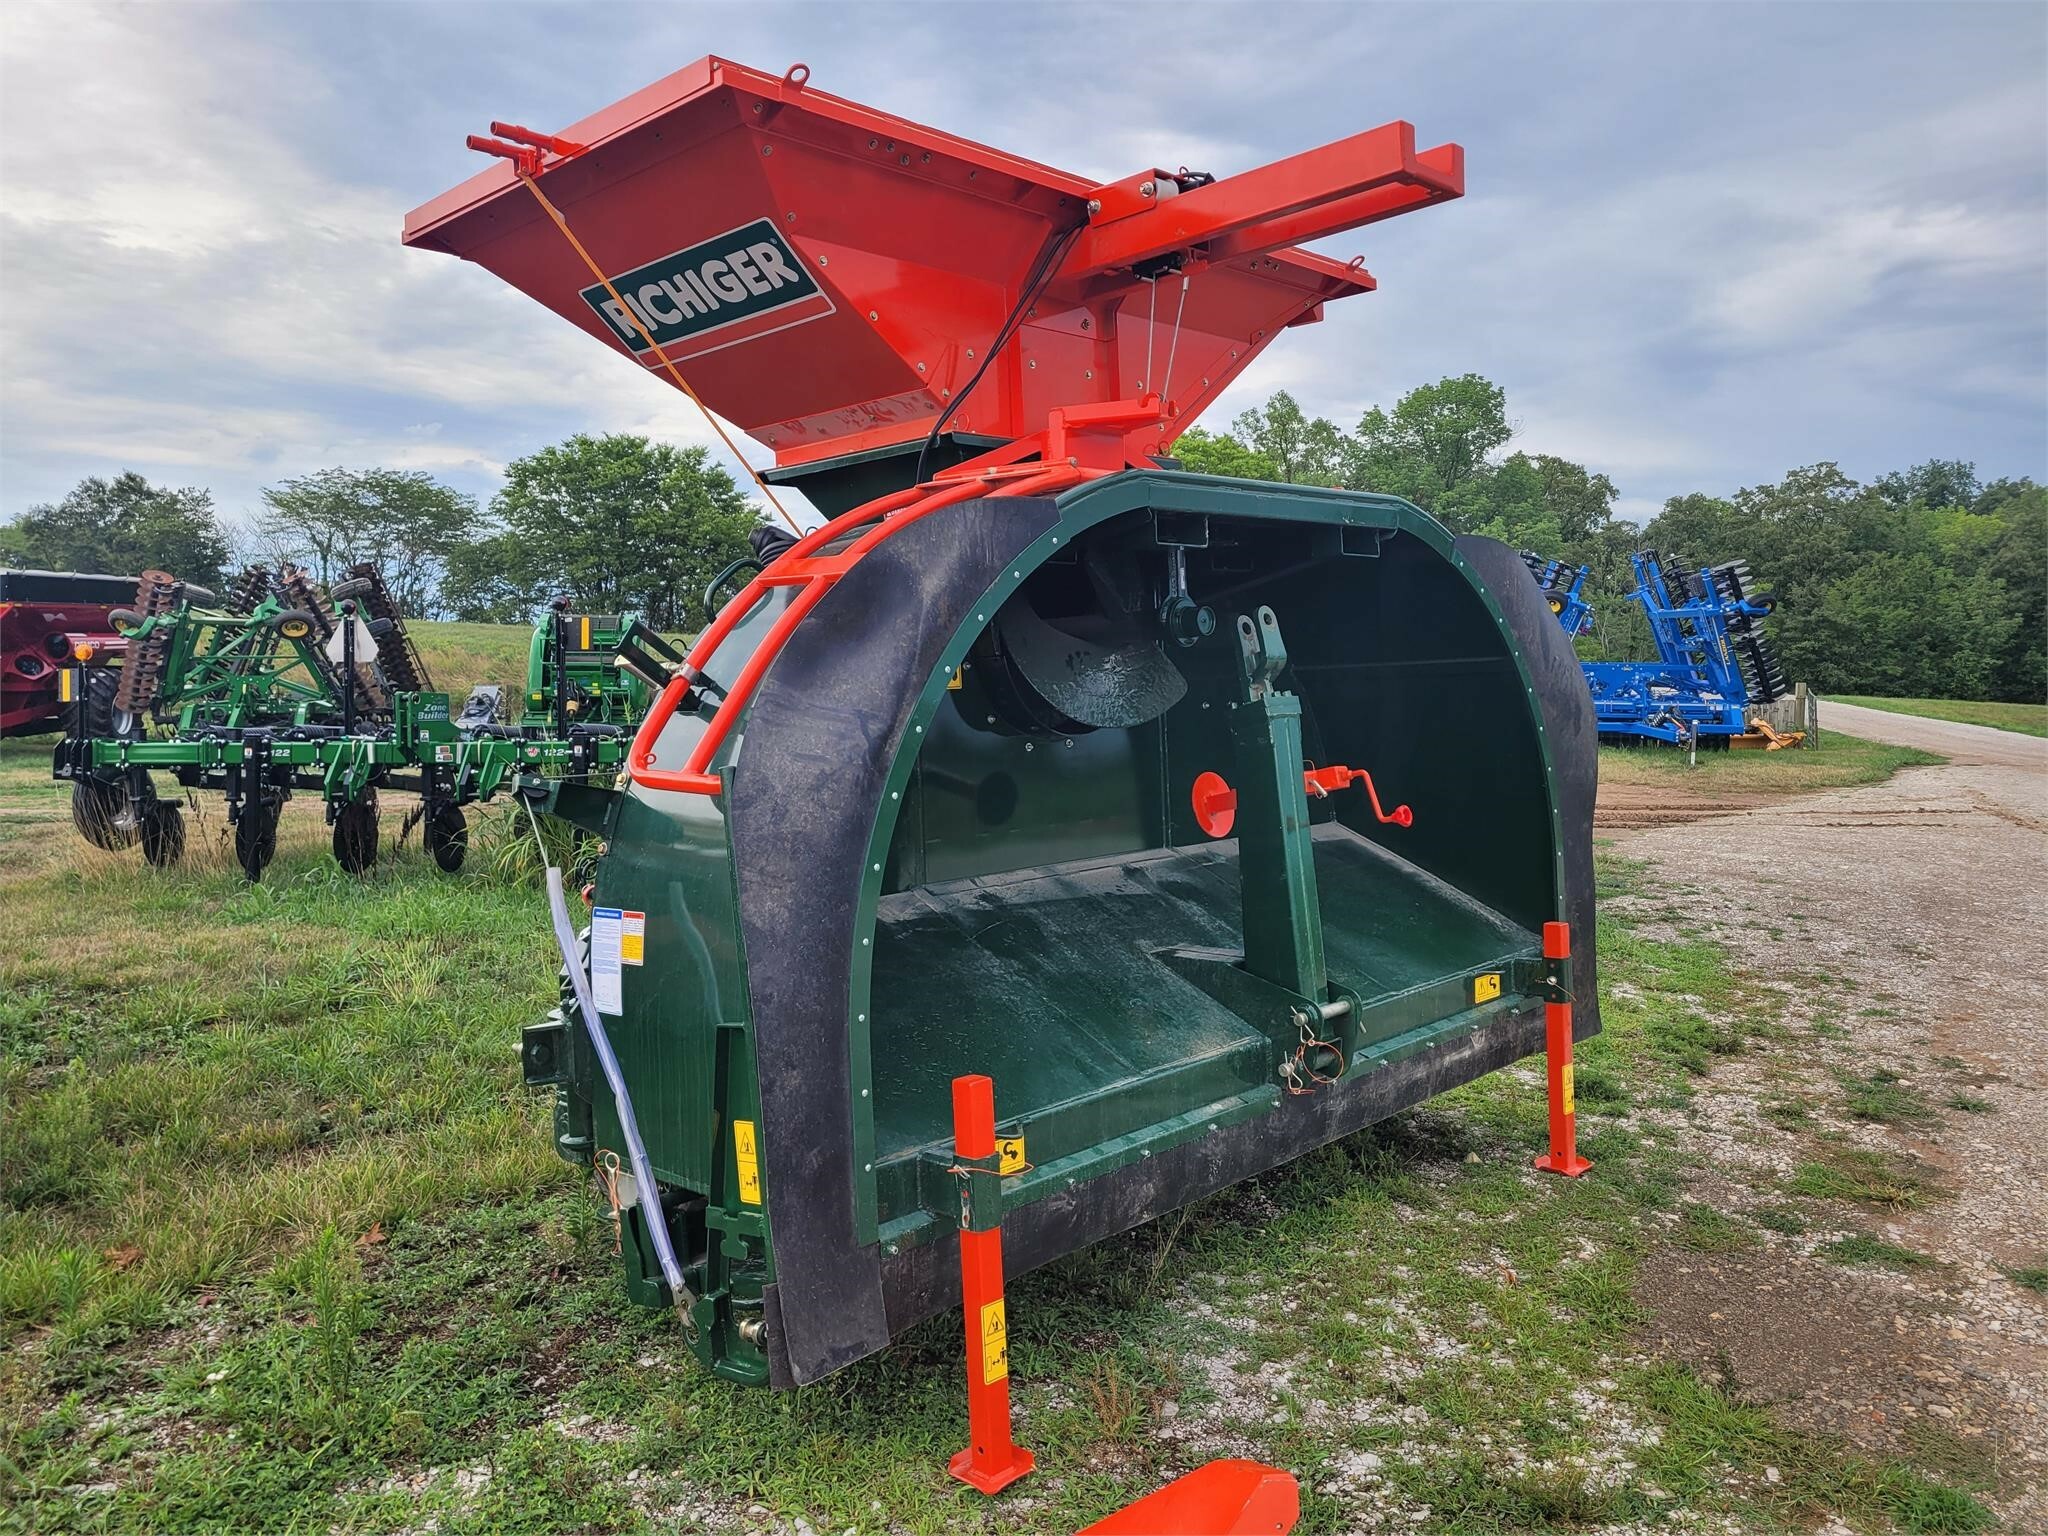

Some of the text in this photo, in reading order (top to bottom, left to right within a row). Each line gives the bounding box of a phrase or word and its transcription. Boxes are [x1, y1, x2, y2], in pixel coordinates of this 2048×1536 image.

[600, 241, 800, 339] RICHIGER
[423, 703, 447, 711] Zone
[417, 711, 449, 720] Builder
[270, 748, 291, 757] 122
